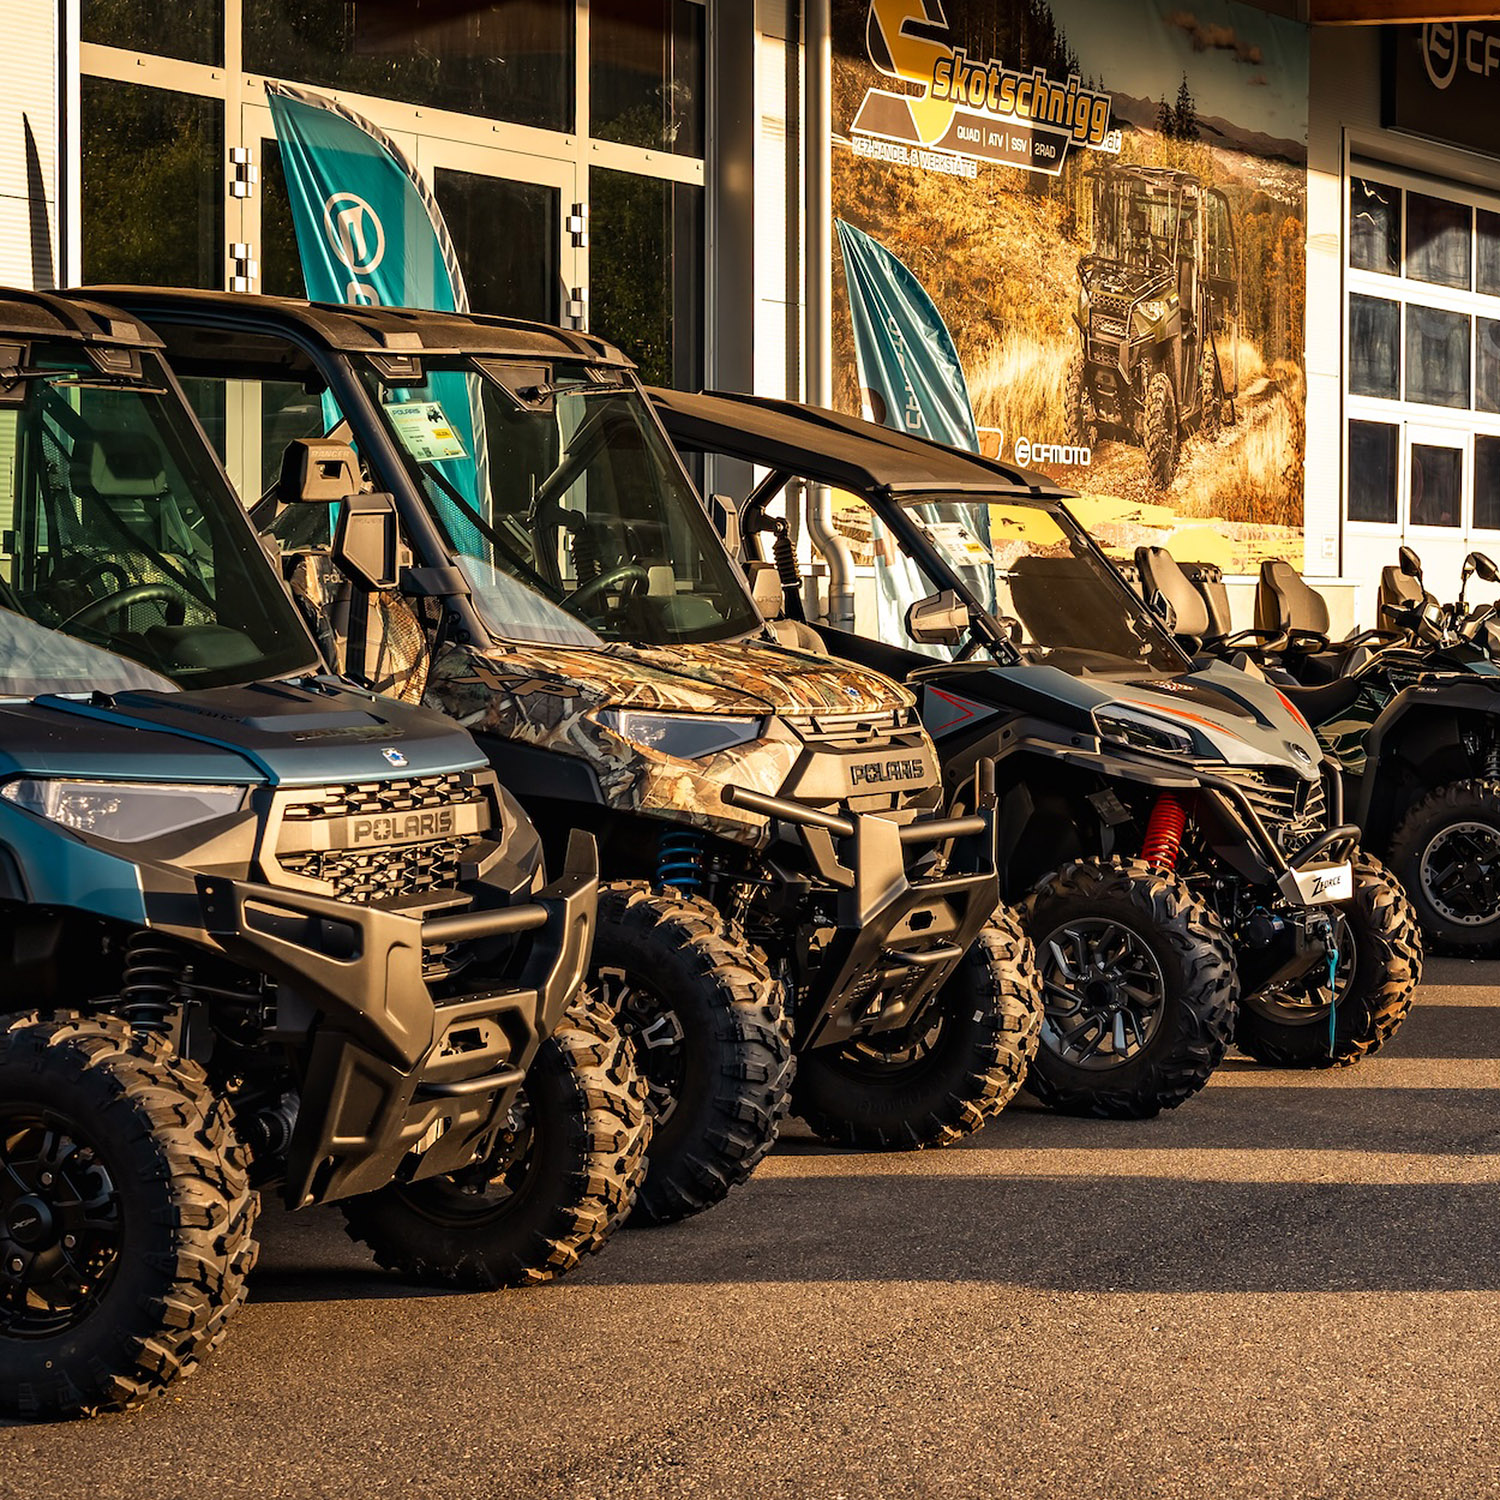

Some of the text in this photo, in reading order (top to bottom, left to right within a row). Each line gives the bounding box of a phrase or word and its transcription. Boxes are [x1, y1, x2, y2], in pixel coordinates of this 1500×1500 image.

[956, 125, 1057, 159] QUAD ATV SSV 2RAD
[311, 450, 351, 458] RANGER
[1031, 442, 1092, 467] CFMOTO
[446, 664, 581, 698] XP
[850, 759, 925, 785] POLARIS
[354, 811, 453, 842] POLARIS
